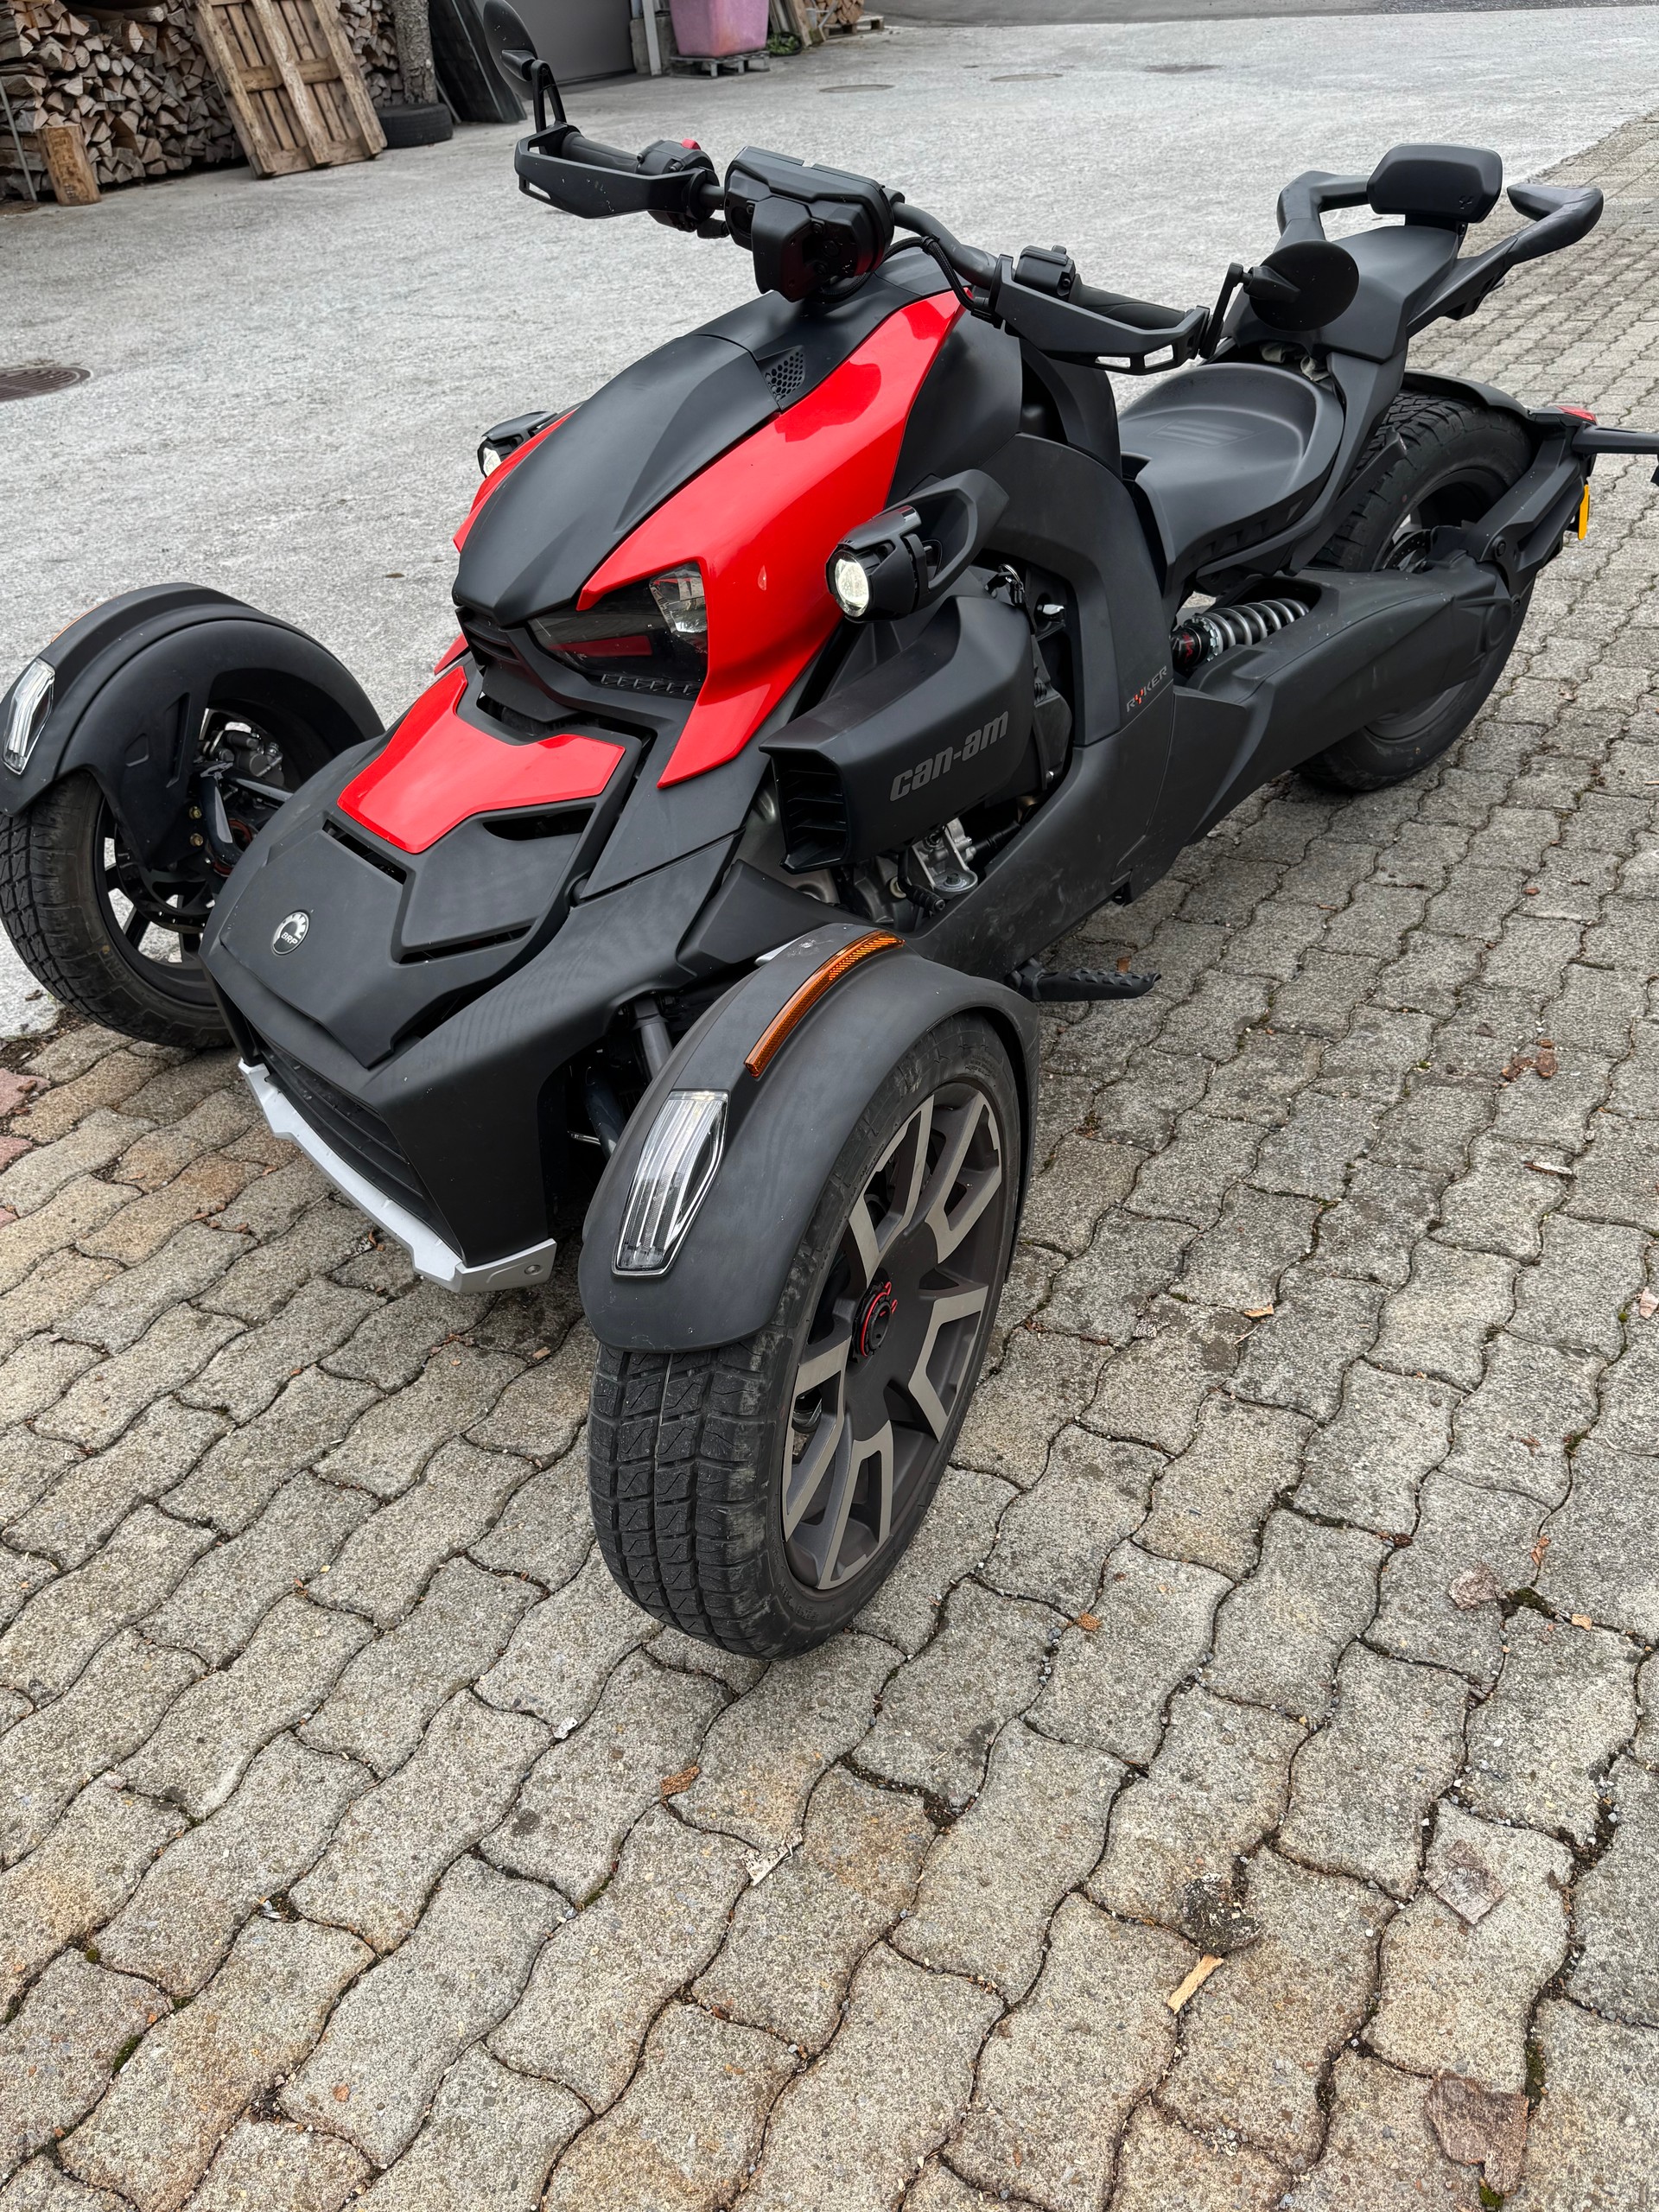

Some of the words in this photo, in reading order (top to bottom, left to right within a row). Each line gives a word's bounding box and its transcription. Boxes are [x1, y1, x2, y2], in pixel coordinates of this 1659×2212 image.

[1126, 664, 1167, 713] RYKER
[889, 710, 1009, 802] can-am
[281, 931, 299, 944] BRP
